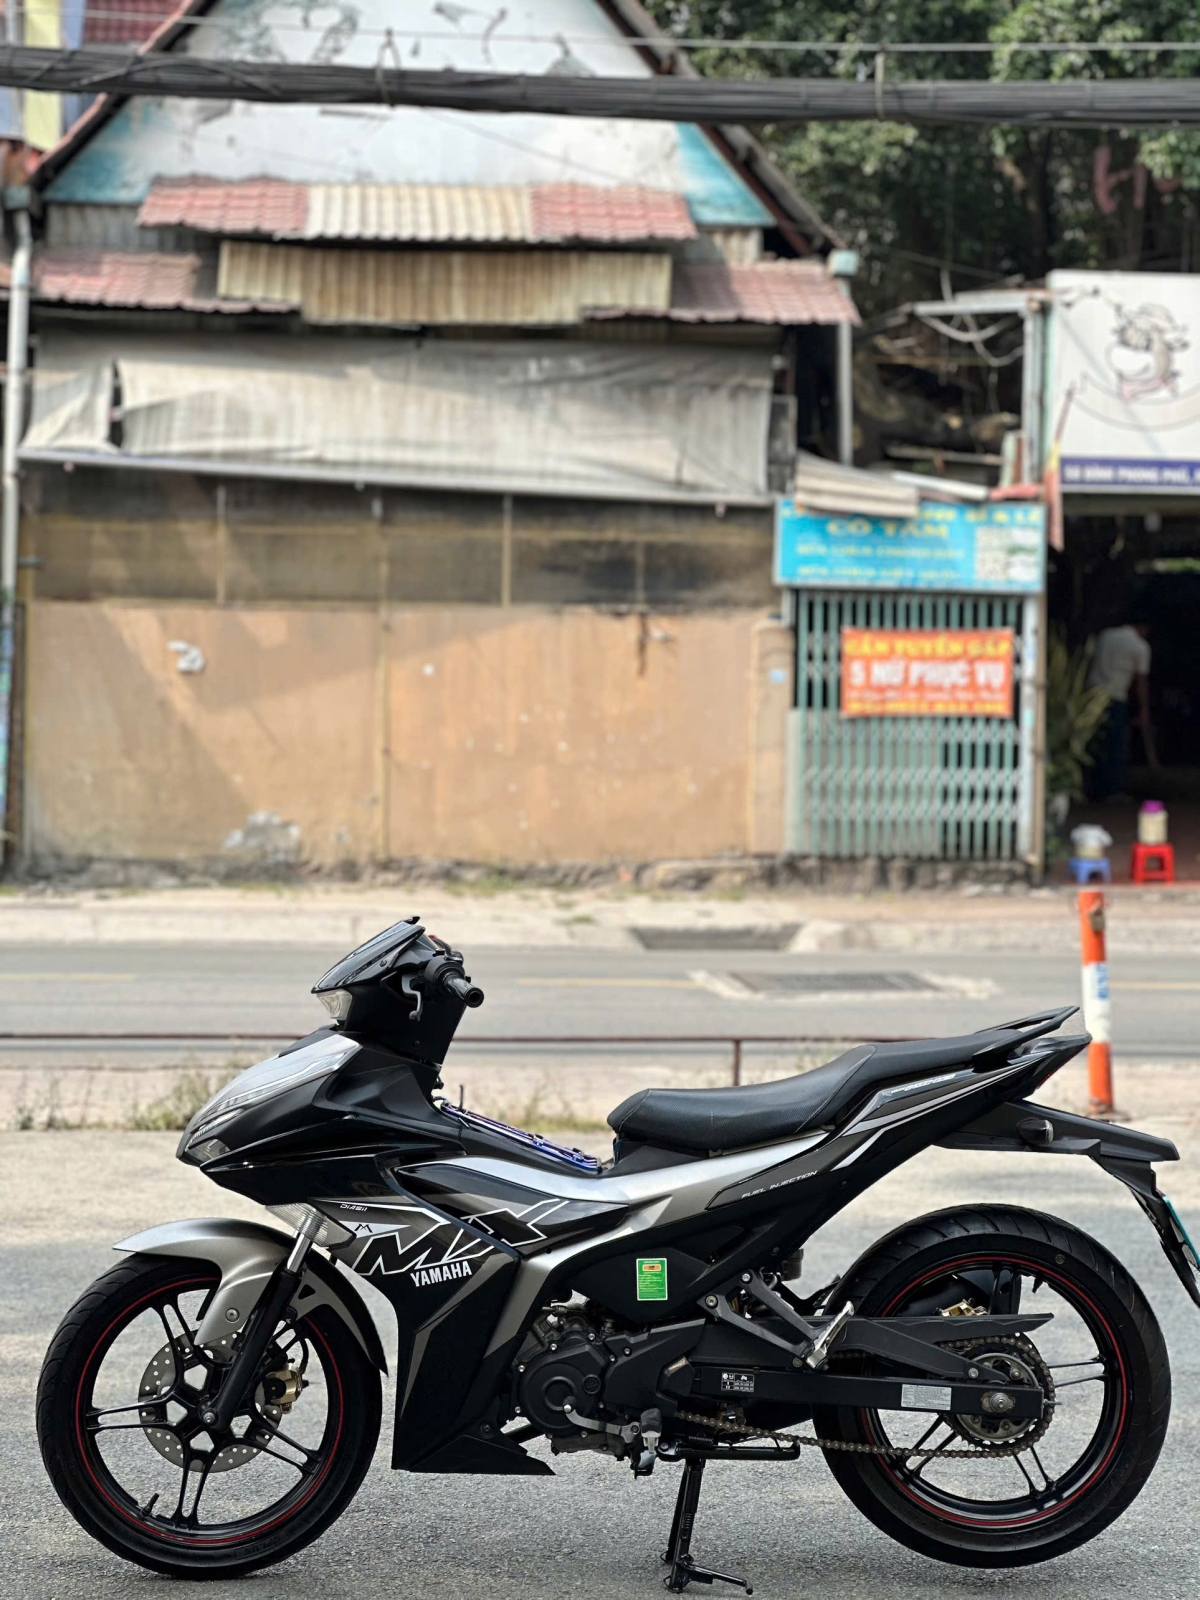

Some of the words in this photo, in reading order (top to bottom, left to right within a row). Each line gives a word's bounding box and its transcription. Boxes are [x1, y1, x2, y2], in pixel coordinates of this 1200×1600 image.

[908, 659, 970, 690] PHỤC
[973, 660, 1006, 690] VỤ
[741, 1187, 766, 1199] FUEL
[769, 1170, 818, 1190] INJECTION
[410, 1260, 472, 1287] YAMAHA
